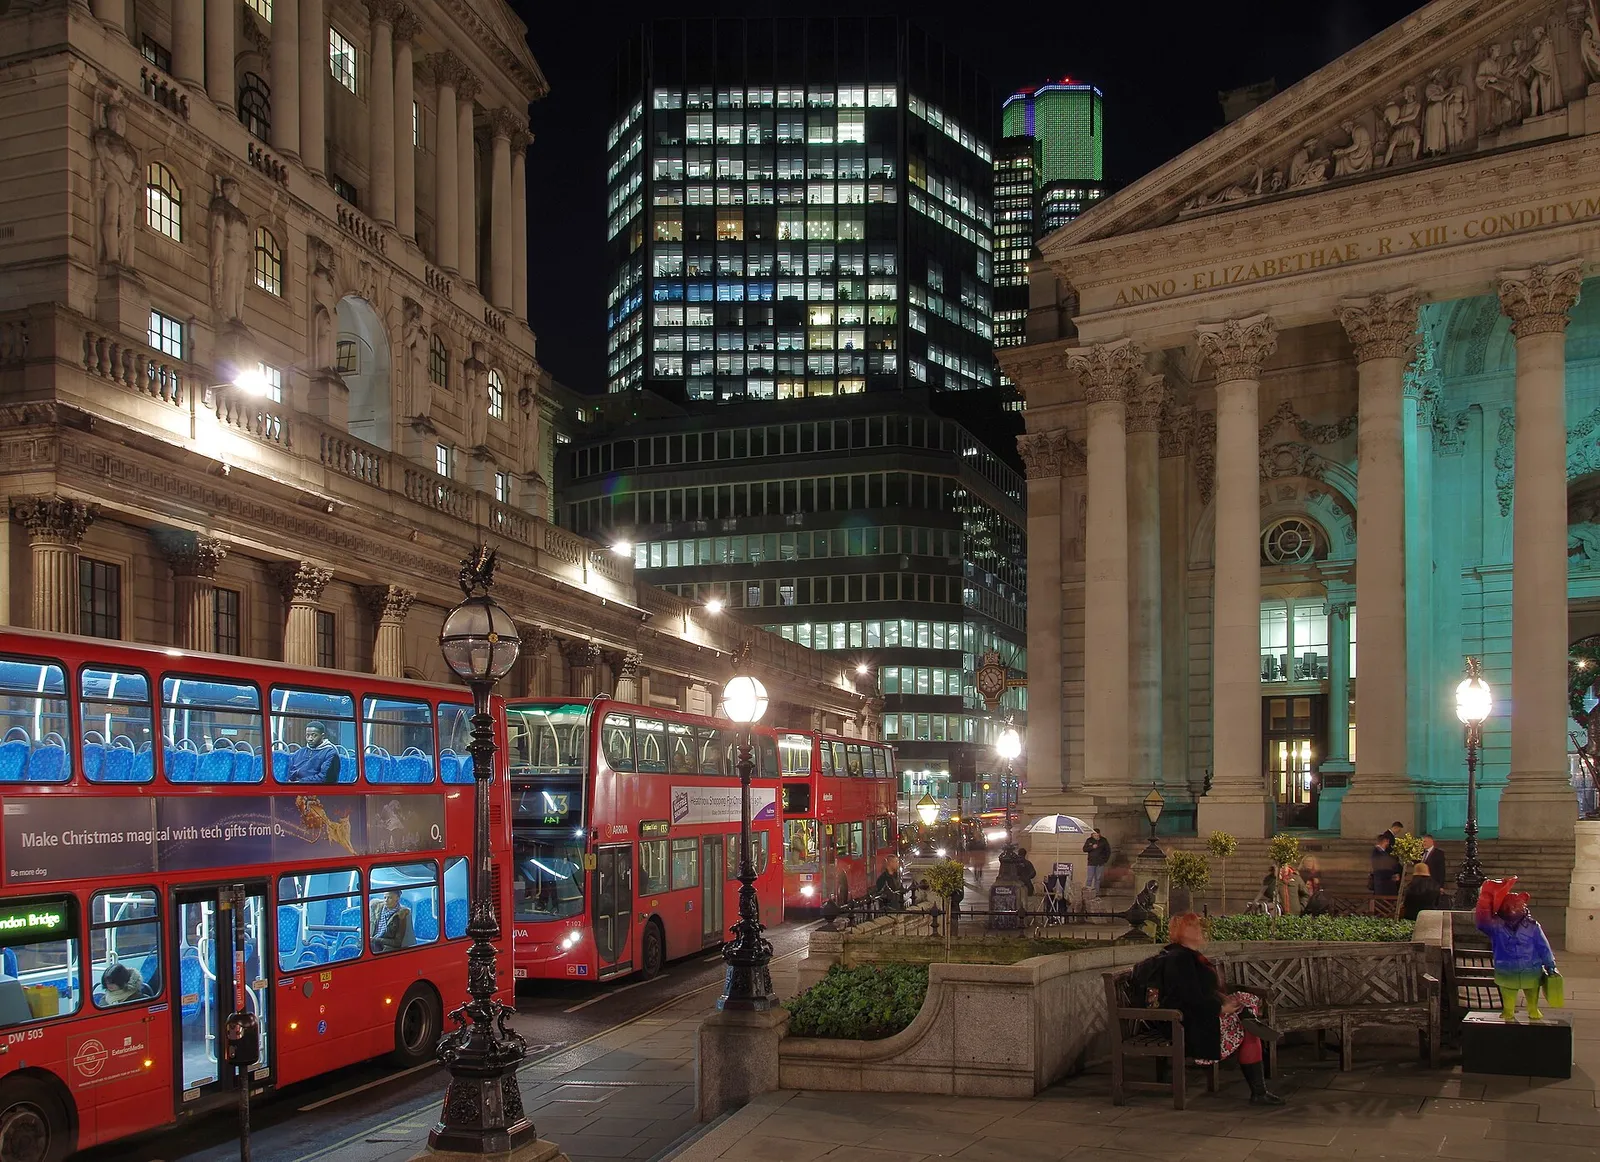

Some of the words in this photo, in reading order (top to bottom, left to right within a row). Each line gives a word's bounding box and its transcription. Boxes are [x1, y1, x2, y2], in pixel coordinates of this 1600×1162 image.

[1114, 279, 1176, 306] ANNO
[1193, 243, 1361, 290] ELIZABETHAE
[1377, 236, 1393, 256] R
[1408, 225, 1448, 250] XIII
[21, 831, 58, 848] Make
[62, 828, 124, 846] Christmas
[127, 827, 171, 845] magical
[172, 826, 198, 840] with
[200, 825, 222, 839] tech
[224, 824, 247, 841] gifts
[249, 824, 271, 836] from
[612, 824, 629, 835] ARRIVA
[10, 869, 19, 877] Be
[19, 869, 35, 877] more
[35, 867, 47, 877] dog
[28, 912, 60, 928] Bridge
[8, 1032, 25, 1044] DW
[27, 1028, 44, 1040] 503
